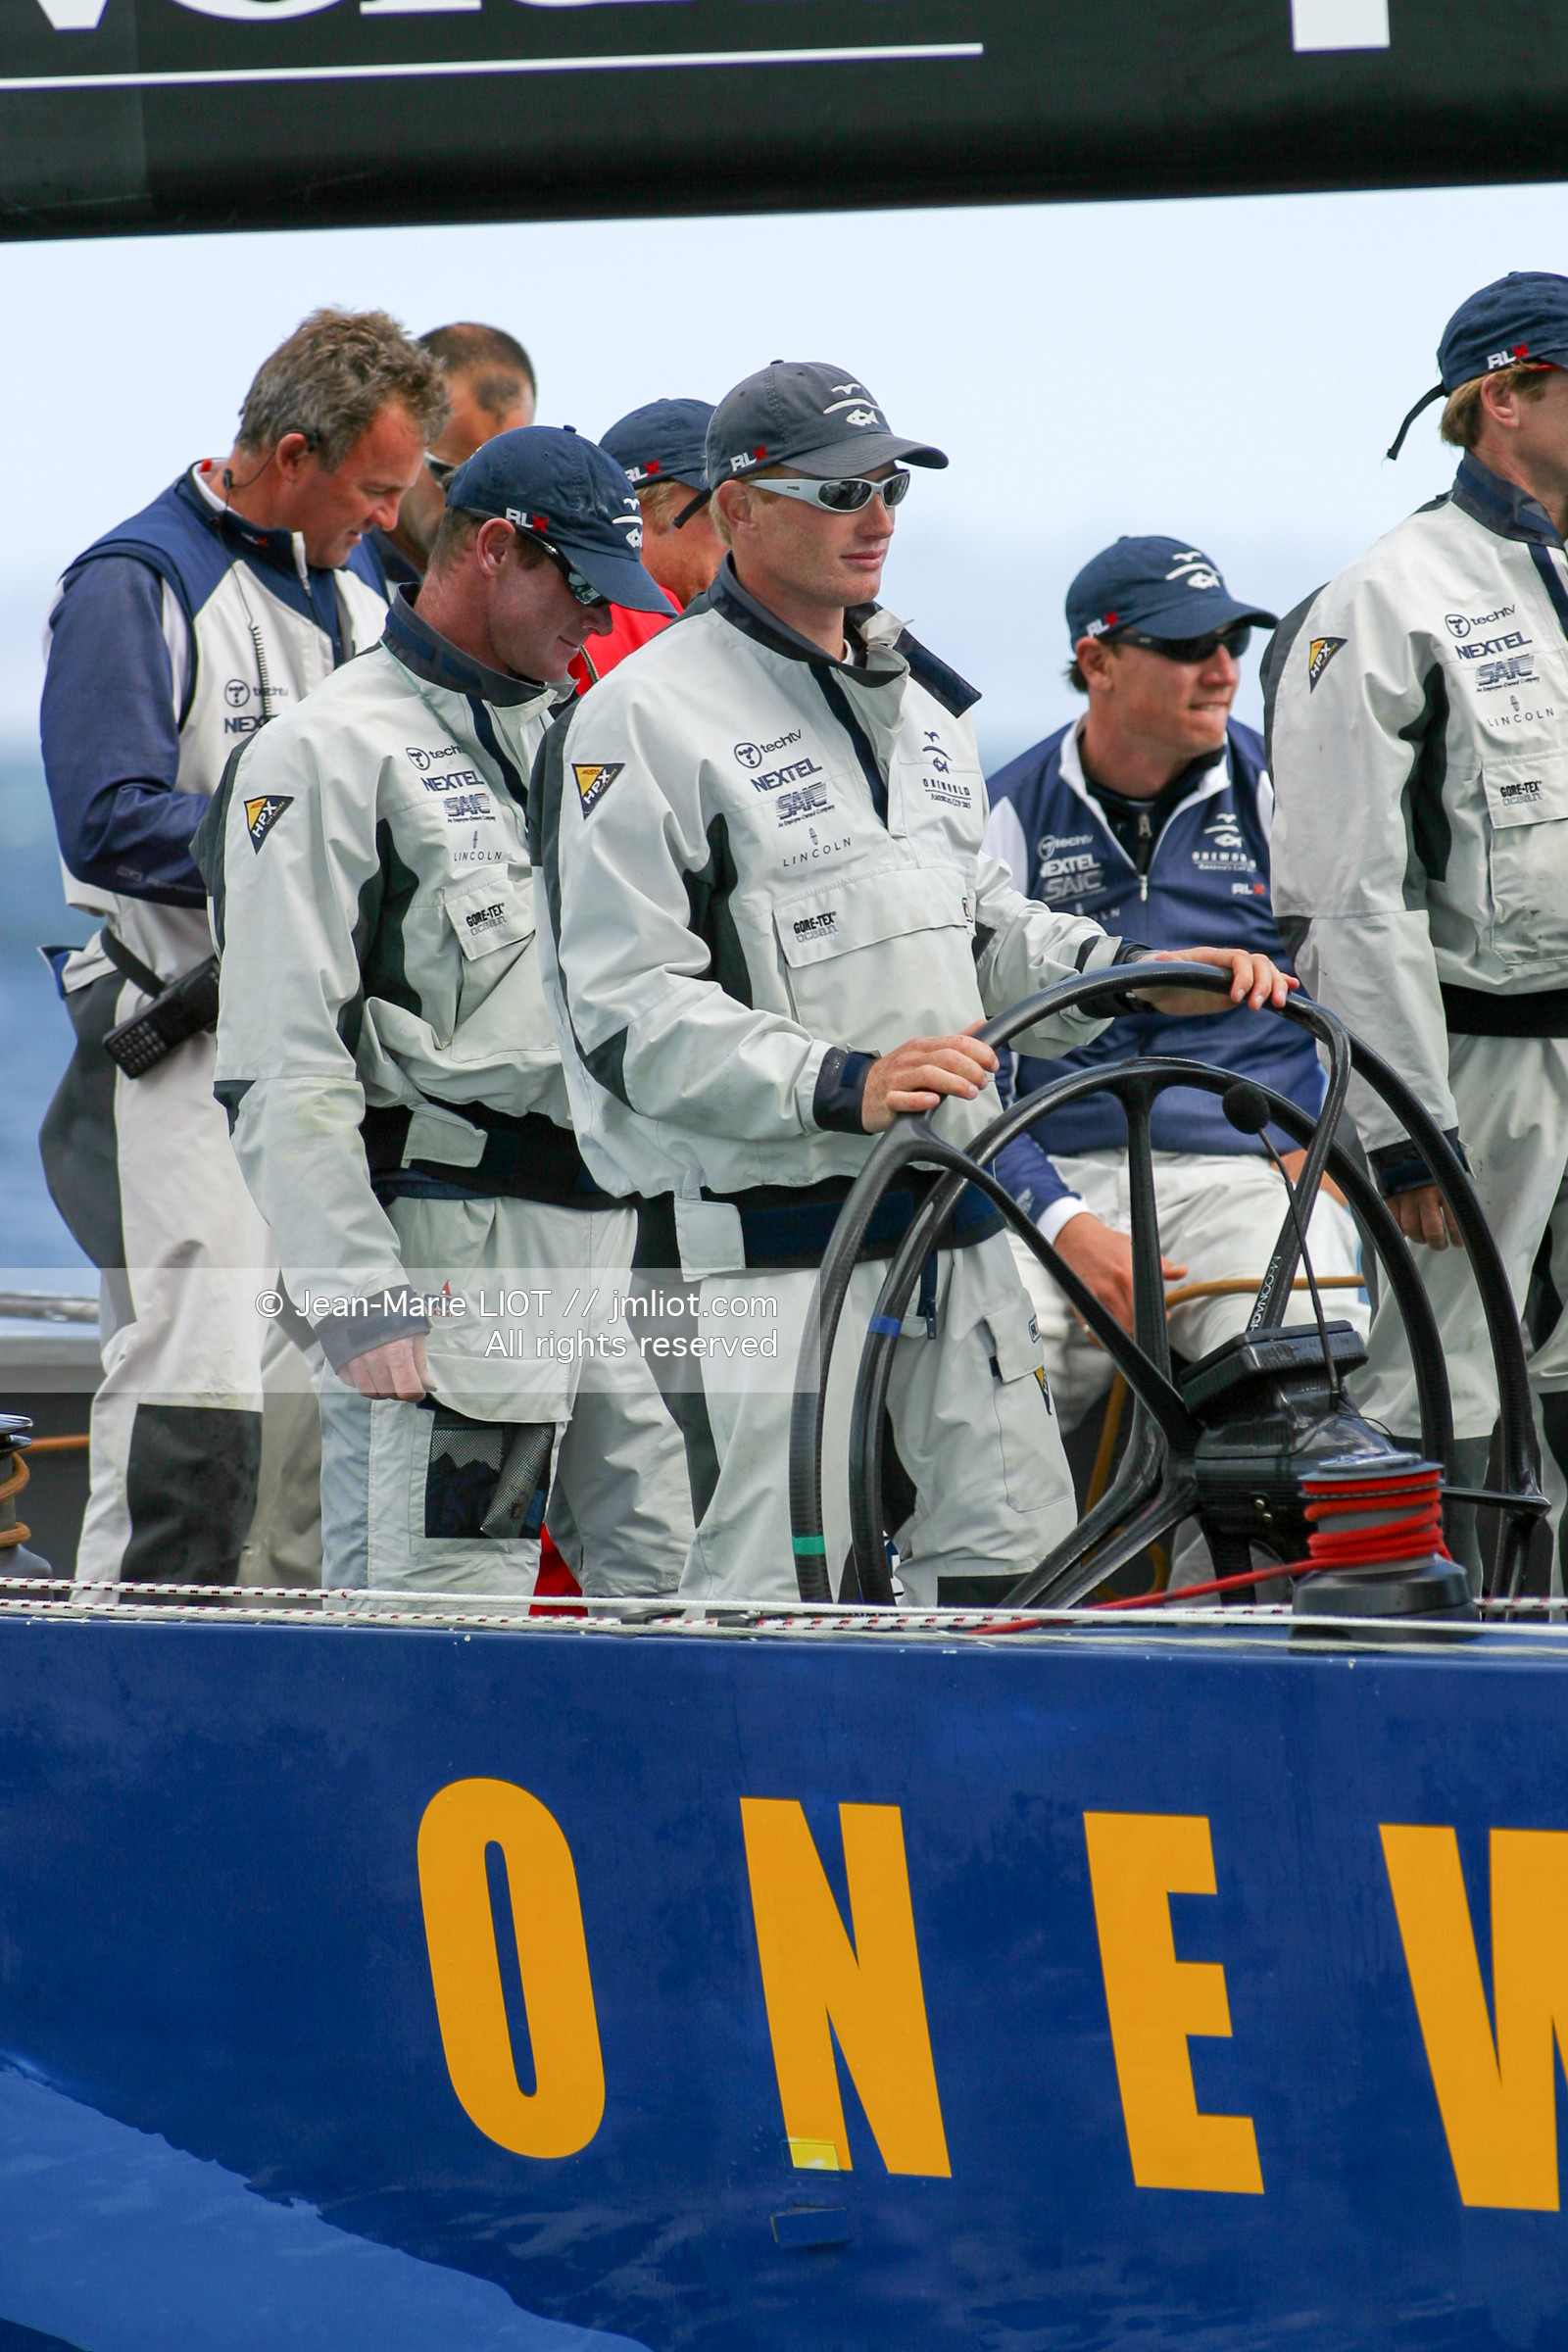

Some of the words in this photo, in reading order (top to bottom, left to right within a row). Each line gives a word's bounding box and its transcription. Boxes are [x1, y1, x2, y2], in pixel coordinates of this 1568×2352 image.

[1487, 343, 1529, 369] RLX
[730, 444, 769, 471] RLX
[506, 507, 550, 533] RLX
[1085, 611, 1119, 637] RLX
[1454, 631, 1533, 660] NEXTEL
[1310, 643, 1331, 678] HPX
[1475, 654, 1535, 686] SAIC
[224, 713, 280, 734] NEX
[1487, 708, 1555, 727] LINCOLN
[429, 745, 465, 760] tech
[420, 770, 484, 792] NEXTEL
[583, 768, 611, 804] HPX
[750, 758, 822, 792] NEXTEL
[1500, 780, 1541, 798] GORE-TEX
[252, 801, 277, 838] HPX
[454, 851, 502, 862] LINCOLN
[783, 837, 852, 867] LINCOLN
[1232, 883, 1264, 896] RLX
[466, 903, 505, 928] GORE-TEX
[794, 911, 835, 934] GORE-TEX
